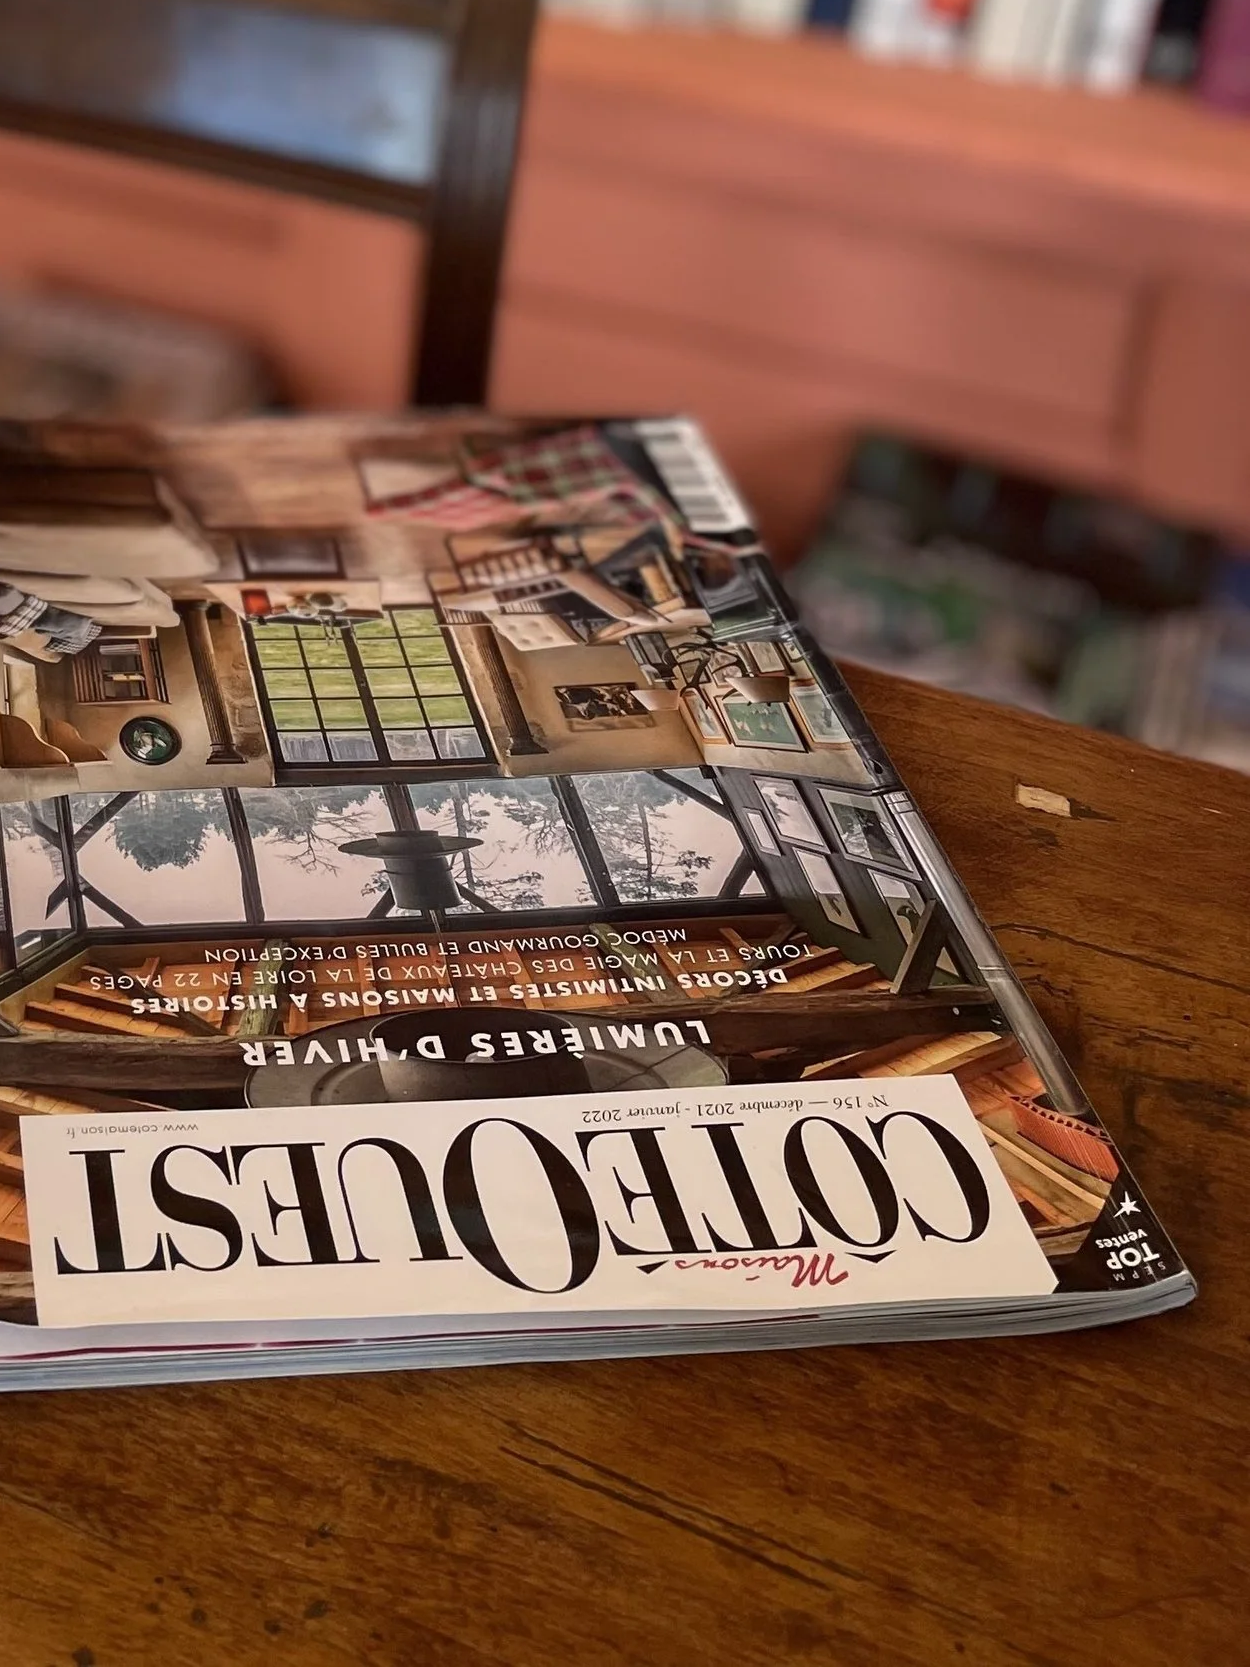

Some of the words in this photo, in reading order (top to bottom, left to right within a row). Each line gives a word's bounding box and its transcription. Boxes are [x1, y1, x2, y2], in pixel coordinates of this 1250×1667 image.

[467, 933, 600, 955] GOURMAND
[605, 928, 687, 947] MÉDOC
[203, 944, 347, 964] D'EXCEPTION
[355, 942, 427, 960] BULLES
[436, 941, 459, 956] ET
[705, 947, 730, 964] ET
[738, 943, 813, 962] TOURS
[530, 957, 574, 975] DES
[583, 952, 658, 972] MAGIE
[667, 950, 695, 966] LA
[211, 971, 242, 987] EN
[252, 968, 317, 986] LOIRE
[325, 968, 353, 983] LA
[363, 965, 390, 982] DE
[400, 960, 522, 981] CHÂTEAUX
[677, 968, 787, 990] DÉCORS
[89, 973, 162, 991] PAGES
[172, 972, 202, 988] 22
[509, 973, 667, 1000] INTIMISTES
[321, 987, 455, 1008] MAISONS
[469, 984, 496, 1002] ET
[129, 993, 277, 1015] HISTOIRES
[284, 992, 308, 1013] À
[470, 1019, 711, 1060] LUMIÈRES
[238, 1034, 444, 1066] D'HIVER
[695, 1102, 735, 1117] 2021
[739, 1097, 804, 1114] décembre
[832, 1094, 863, 1110] 156
[867, 1093, 890, 1109] N°
[581, 1108, 622, 1123] 2022
[626, 1102, 681, 1119] janvier
[66, 1123, 199, 1139] www.cotemaison.fr
[1095, 1229, 1148, 1249] ventes
[1106, 1242, 1160, 1270] TOP
[674, 1252, 849, 1288] Maisons
